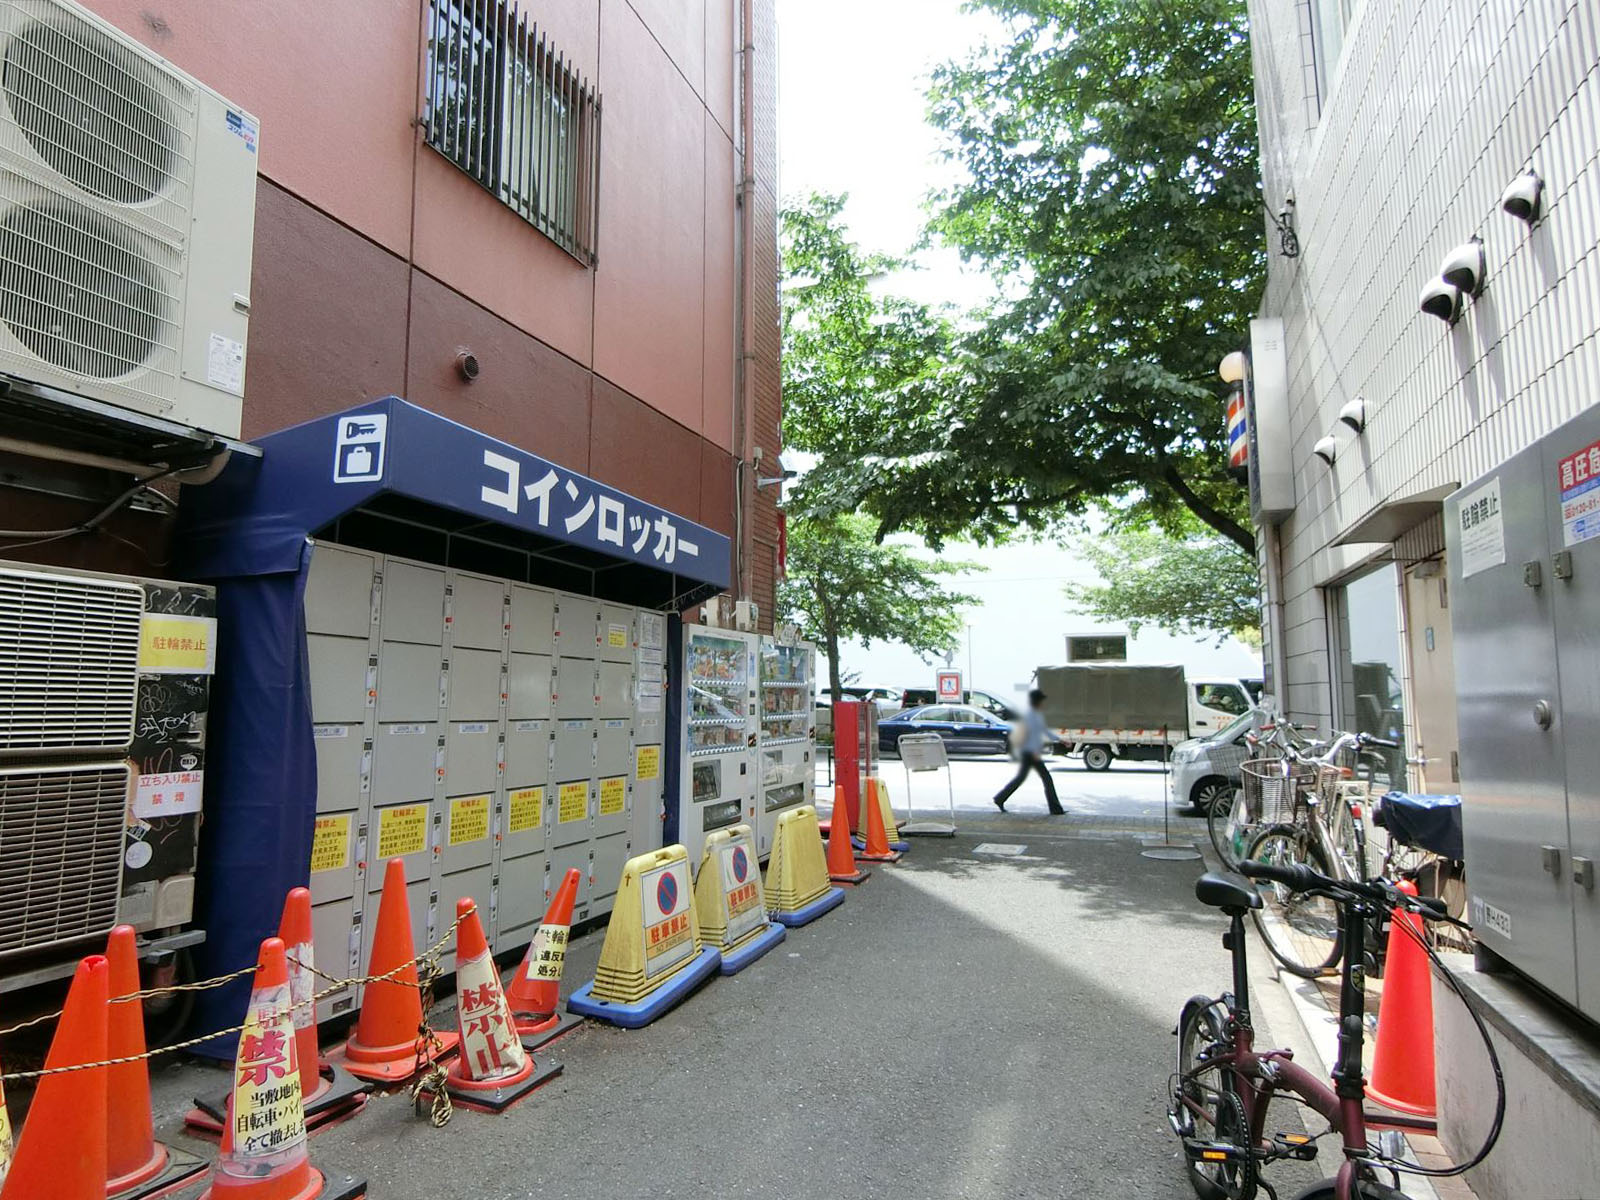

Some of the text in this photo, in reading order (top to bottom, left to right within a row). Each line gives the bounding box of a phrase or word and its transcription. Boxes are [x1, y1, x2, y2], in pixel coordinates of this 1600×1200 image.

[481, 449, 699, 564] コインロッカー
[1461, 491, 1499, 531] 駐輪禁止
[152, 636, 206, 651] 駐輪禁止
[140, 774, 201, 788] 立ち入り禁止
[651, 913, 688, 944] 駐車禁止
